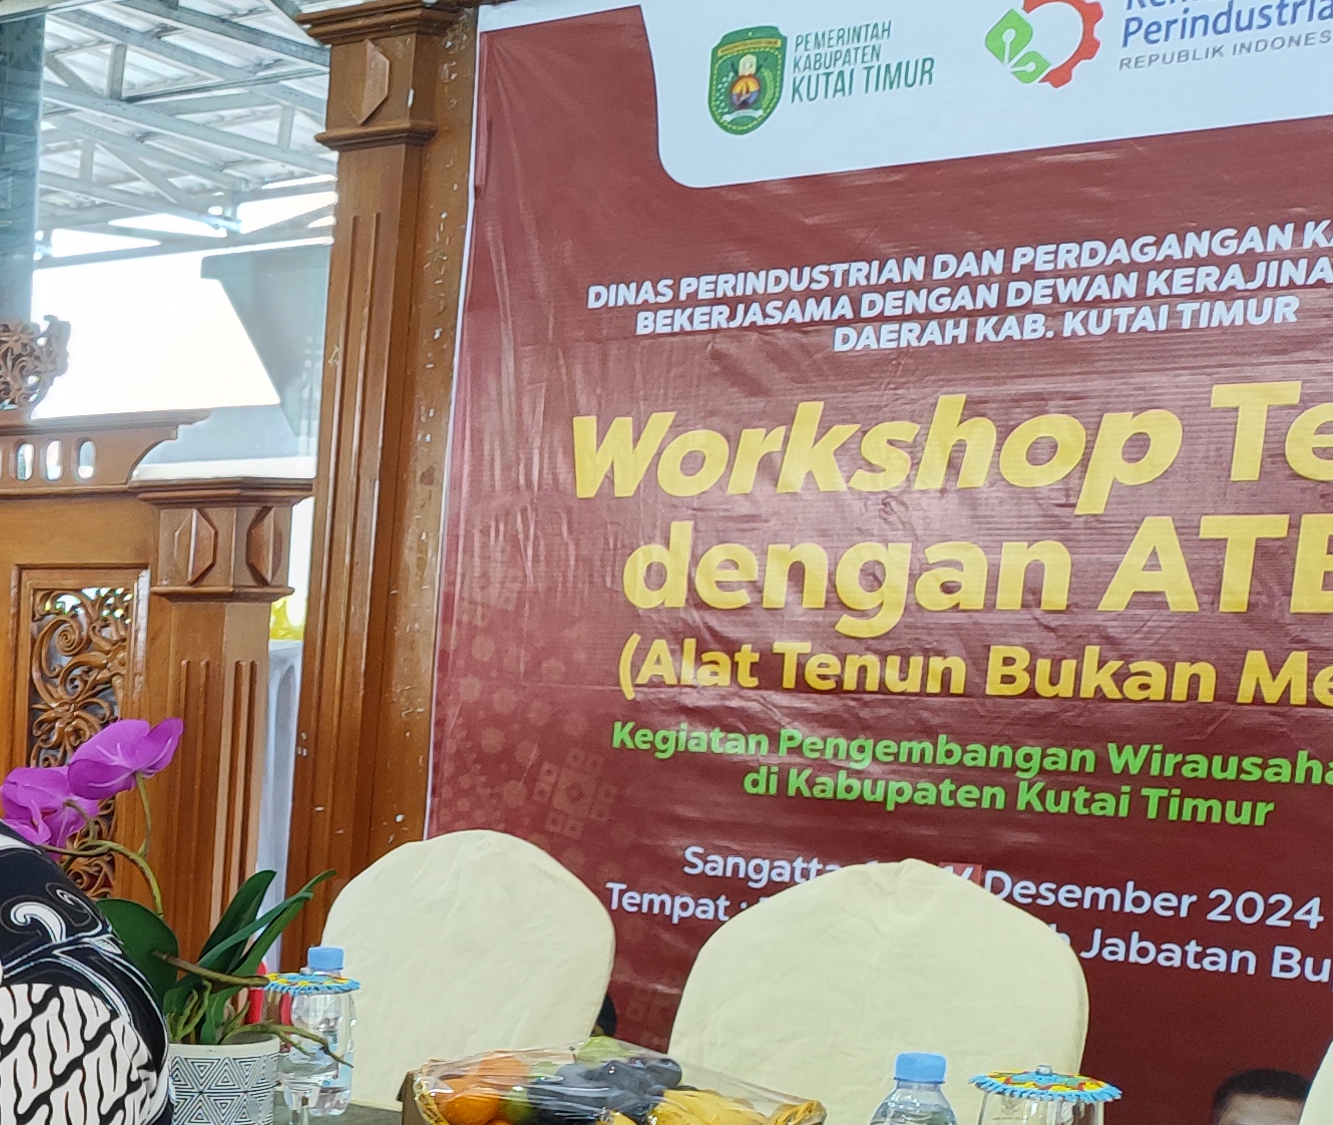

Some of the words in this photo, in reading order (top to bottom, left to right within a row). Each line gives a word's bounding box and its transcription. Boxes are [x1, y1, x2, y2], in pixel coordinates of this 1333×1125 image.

[793, 44, 881, 74] KABUPATEN
[795, 20, 892, 52] PEMERINTAH
[1119, 44, 1224, 71] REPUBLIK
[1233, 30, 1332, 55] INDONES
[791, 68, 854, 103] KUTAI
[863, 57, 935, 93] TIMUR
[587, 279, 674, 309] DINAS
[678, 256, 925, 301] PERINDUSTRIAN
[932, 249, 1004, 280] DAN
[1011, 222, 1295, 273] PERDAGANGAN
[1302, 219, 1333, 250] K
[635, 296, 853, 335] BEKERJASAMA
[860, 282, 999, 318] DENGAN
[1006, 272, 1138, 307] DEWAN
[1146, 255, 1333, 297] KERAJINA
[833, 318, 967, 352] DAERAH
[974, 315, 1054, 342] KAB.
[1063, 304, 1169, 337] KUTAI
[1177, 296, 1299, 329] TIMUR
[572, 394, 1183, 515] Workshop
[1210, 381, 1333, 481] Te
[623, 520, 1072, 638] dengan
[619, 632, 760, 700] (Alat
[773, 641, 966, 694] Tenun
[985, 645, 1217, 702] Bukan
[612, 720, 769, 759] Kegiatan
[778, 728, 1096, 778] Pengembangan
[1107, 742, 1333, 785] Wirausah
[743, 766, 779, 796] di
[787, 768, 1005, 811] Kabupaten
[1016, 781, 1131, 818] Kutai
[1141, 787, 1276, 826] Timur
[605, 882, 731, 924] Tempat
[1079, 928, 1256, 975] Jabatan
[984, 870, 1197, 918] Desember
[1206, 888, 1325, 930] 2024
